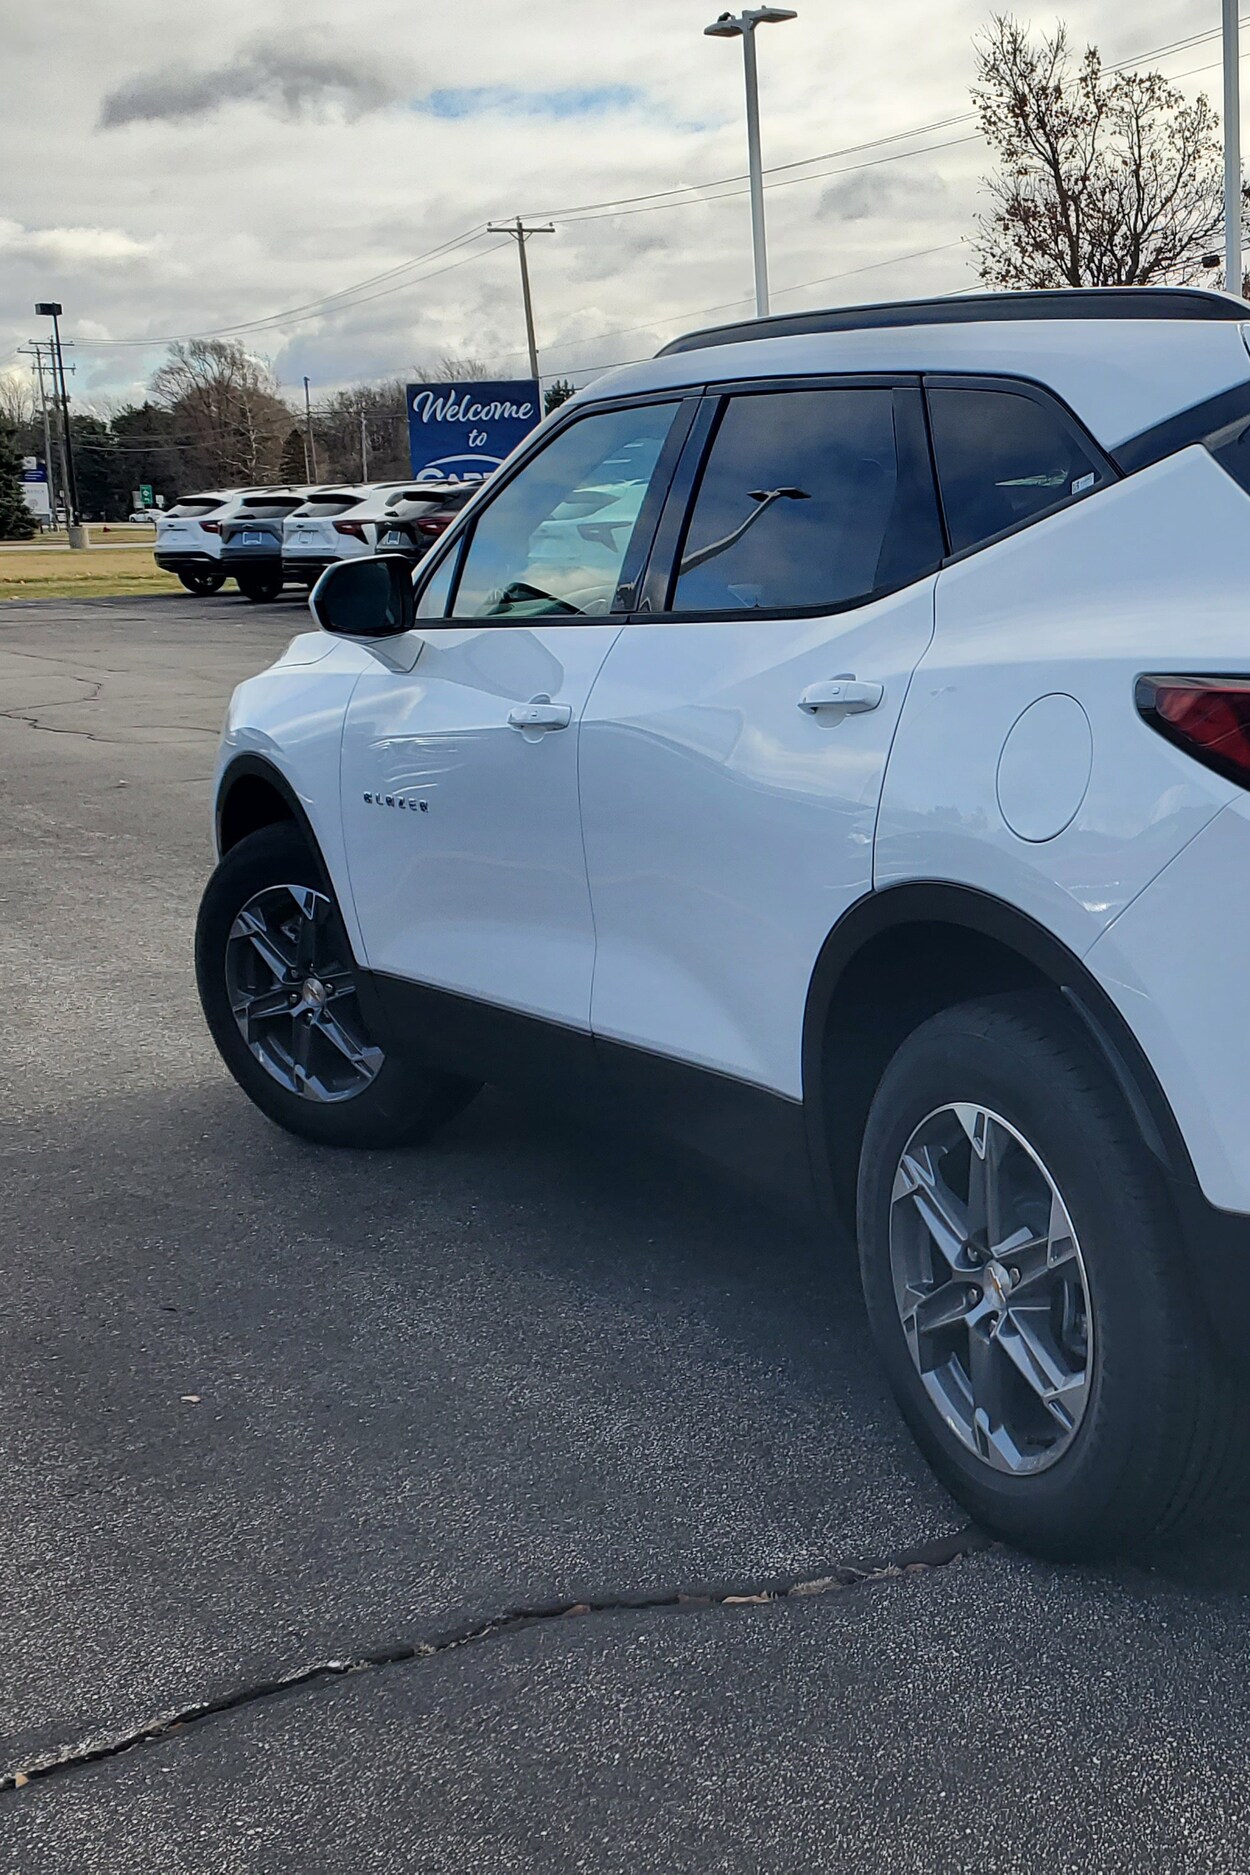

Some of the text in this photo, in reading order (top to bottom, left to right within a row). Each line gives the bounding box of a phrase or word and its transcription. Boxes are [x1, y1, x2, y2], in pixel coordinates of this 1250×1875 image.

[412, 389, 534, 423] Welcome
[468, 428, 488, 447] to
[363, 791, 429, 813] BLAZER
